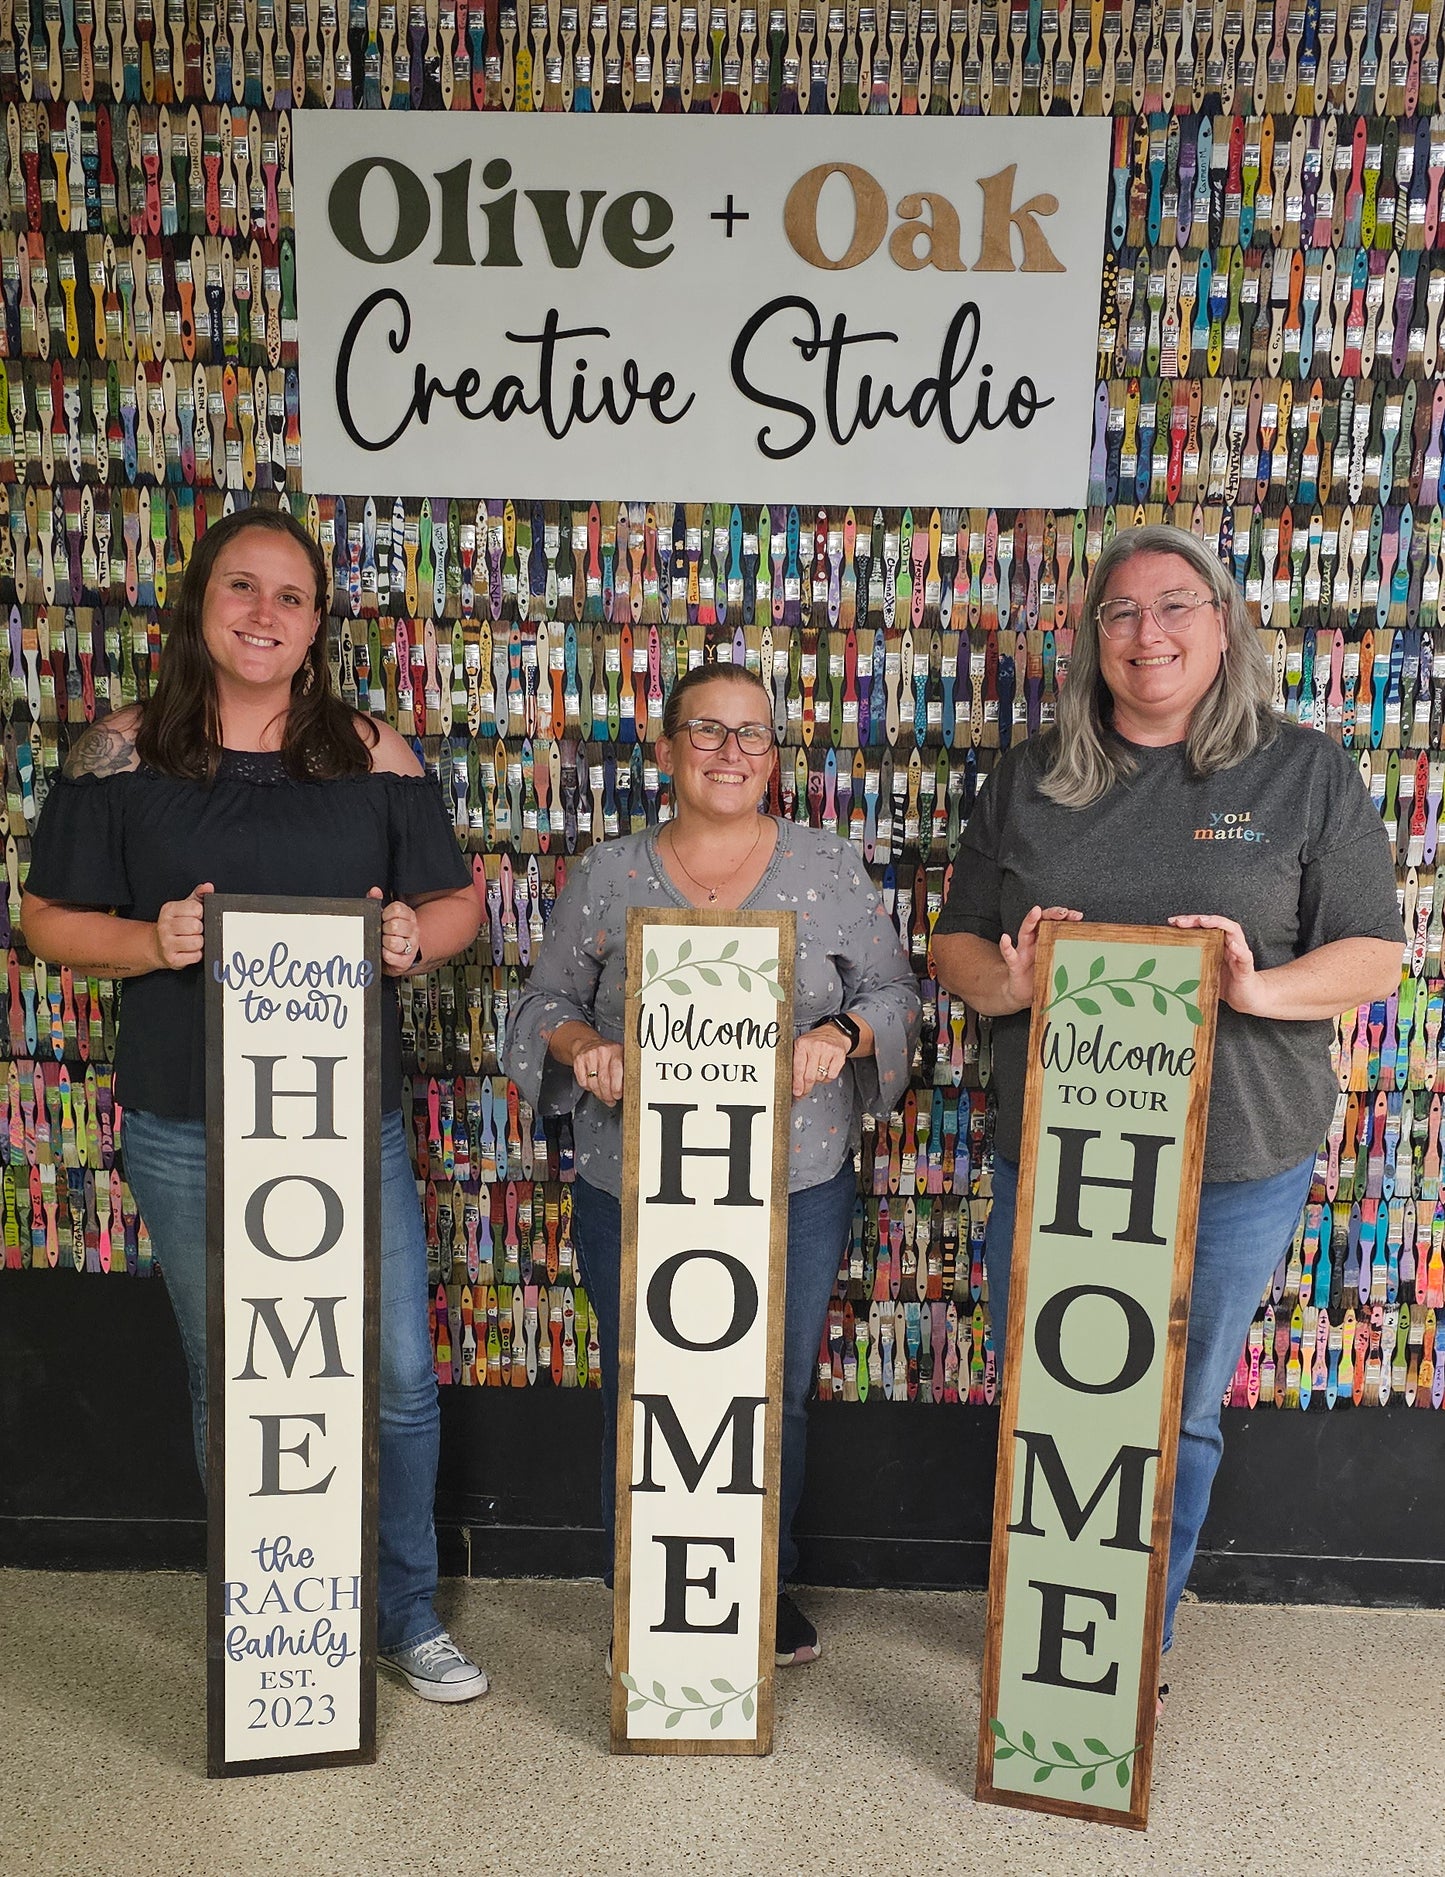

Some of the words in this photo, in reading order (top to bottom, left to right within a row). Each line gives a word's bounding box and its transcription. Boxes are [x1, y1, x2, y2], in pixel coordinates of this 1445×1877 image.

[1226, 47, 1234, 81] BRIANDA
[1408, 67, 1417, 94] Smile
[190, 132, 200, 183] JOHNSON
[1199, 165, 1207, 194] Carmen
[327, 156, 674, 269] Olive
[710, 194, 749, 238] +
[783, 161, 1067, 273] Oak
[334, 287, 696, 452] Creative
[729, 294, 1055, 460] Studio
[197, 385, 205, 410] ERIN
[1160, 412, 1169, 438] Rita
[98, 535, 109, 583] STEF
[650, 644, 658, 693] JULES
[608, 702, 617, 716] SB
[1193, 826, 1270, 842] matter.
[1209, 811, 1251, 826] you
[1416, 917, 1427, 950] ROXY
[213, 941, 374, 990] welcome
[238, 989, 281, 1023] to
[285, 989, 348, 1029] our
[636, 1003, 781, 1051] Welcome
[1040, 1021, 1197, 1077] Welcome
[655, 1062, 692, 1082] TO
[700, 1063, 758, 1083] OUR
[1058, 1085, 1097, 1106] TO
[1105, 1088, 1168, 1112] OUR
[231, 1055, 355, 1497] HOME
[501, 1327, 510, 1350] BOO!
[628, 1102, 769, 1634] HOME
[1005, 1126, 1176, 1696] HOME
[251, 1535, 315, 1573] the
[220, 1575, 364, 1617] RACH
[226, 1617, 356, 1668] family
[259, 1668, 316, 1690] EST.
[246, 1694, 336, 1730] 2023
